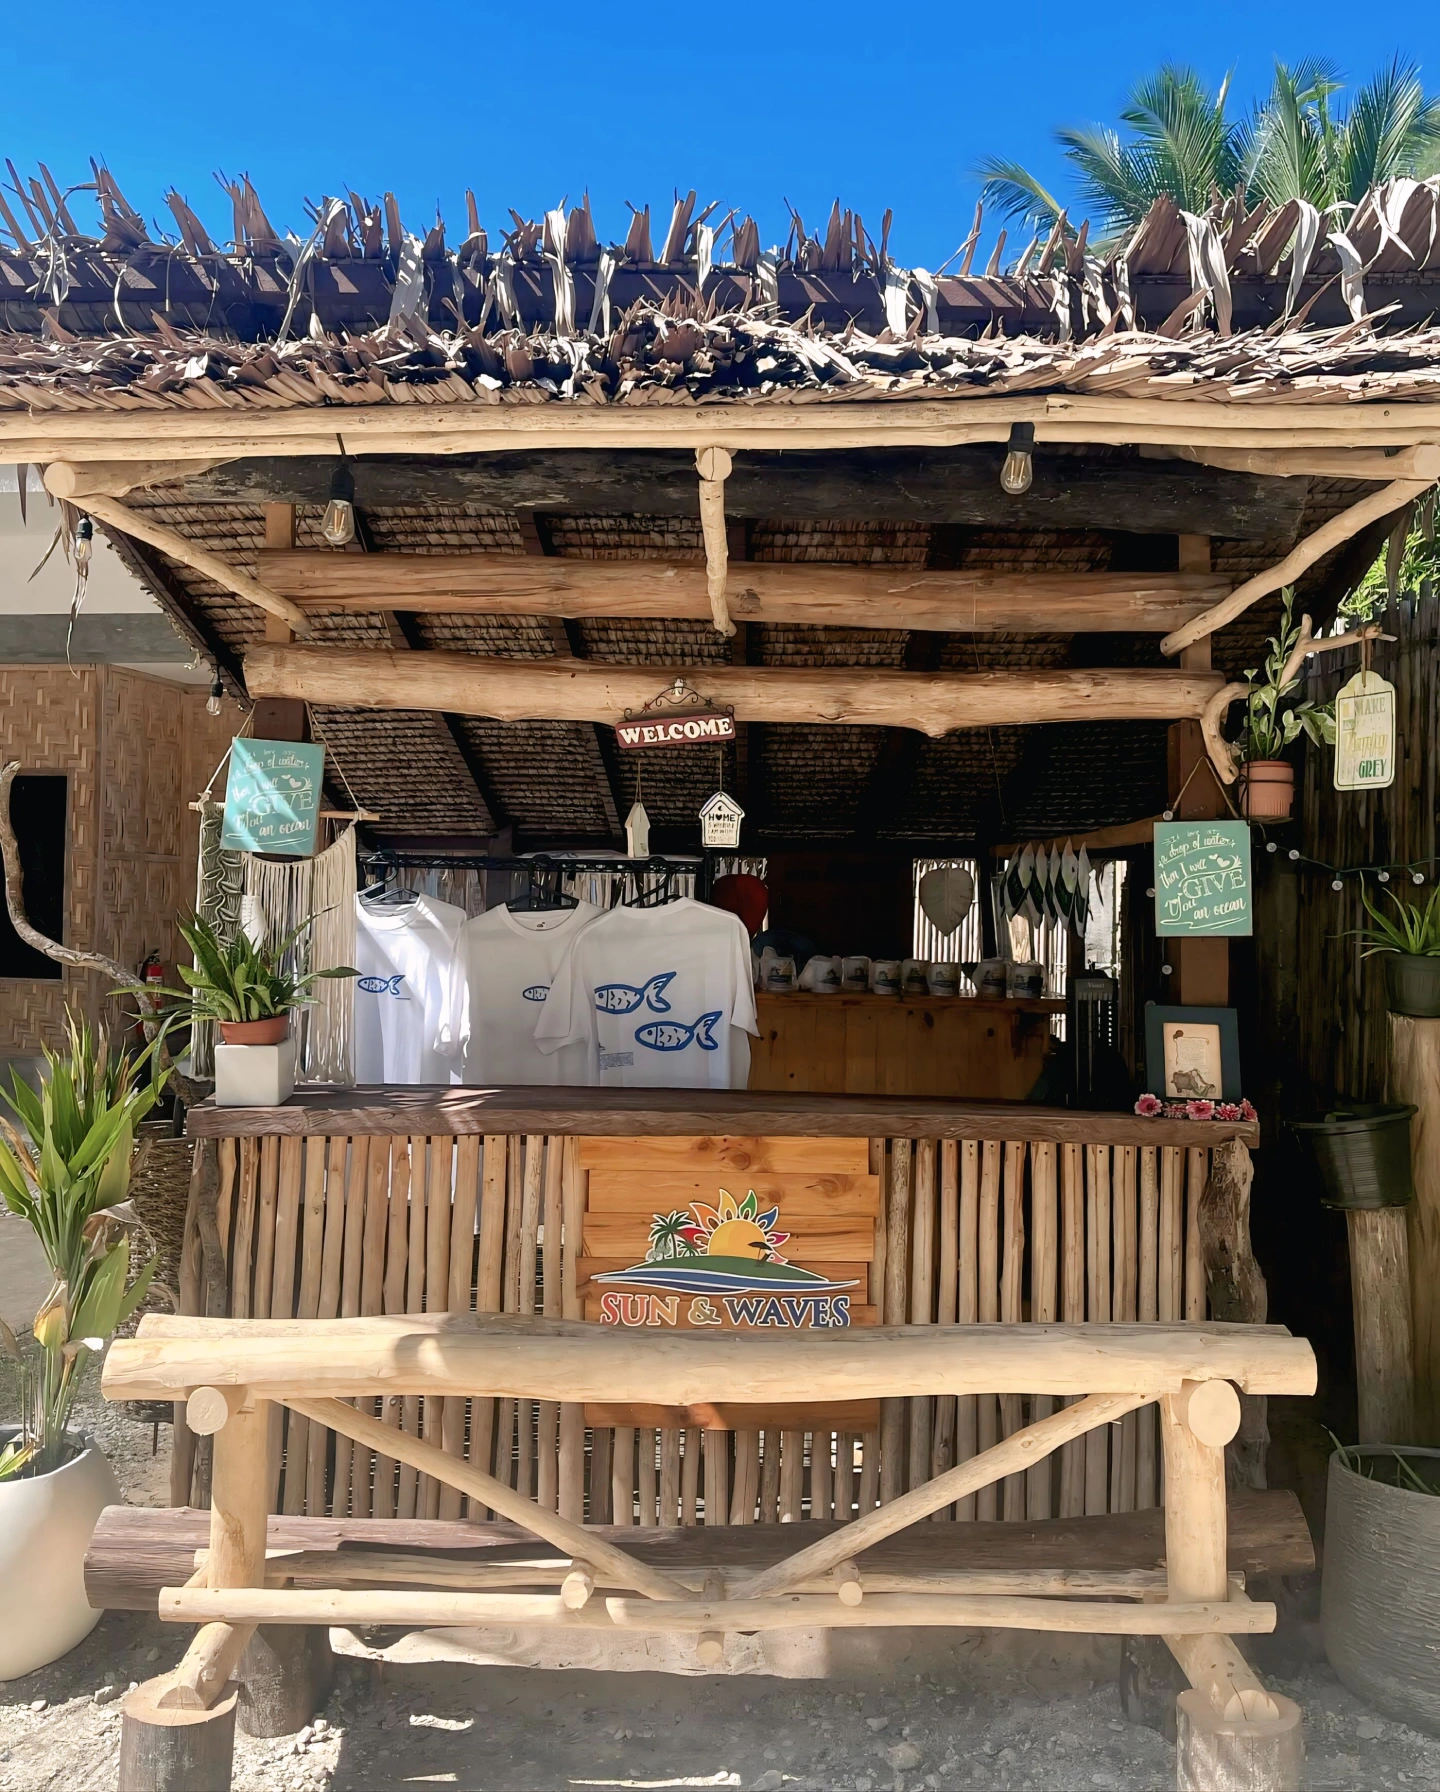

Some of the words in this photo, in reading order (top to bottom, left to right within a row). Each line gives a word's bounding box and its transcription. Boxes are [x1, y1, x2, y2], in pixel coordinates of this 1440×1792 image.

[619, 718, 732, 744] WELCOME
[1358, 758, 1387, 779] GREY
[259, 824, 276, 837] an
[1182, 869, 1246, 899] GIVE
[1193, 906, 1212, 920] an
[1213, 897, 1247, 915] ocean
[599, 1291, 680, 1327] SUN
[687, 1296, 722, 1325] &
[723, 1295, 851, 1329] WAVES
